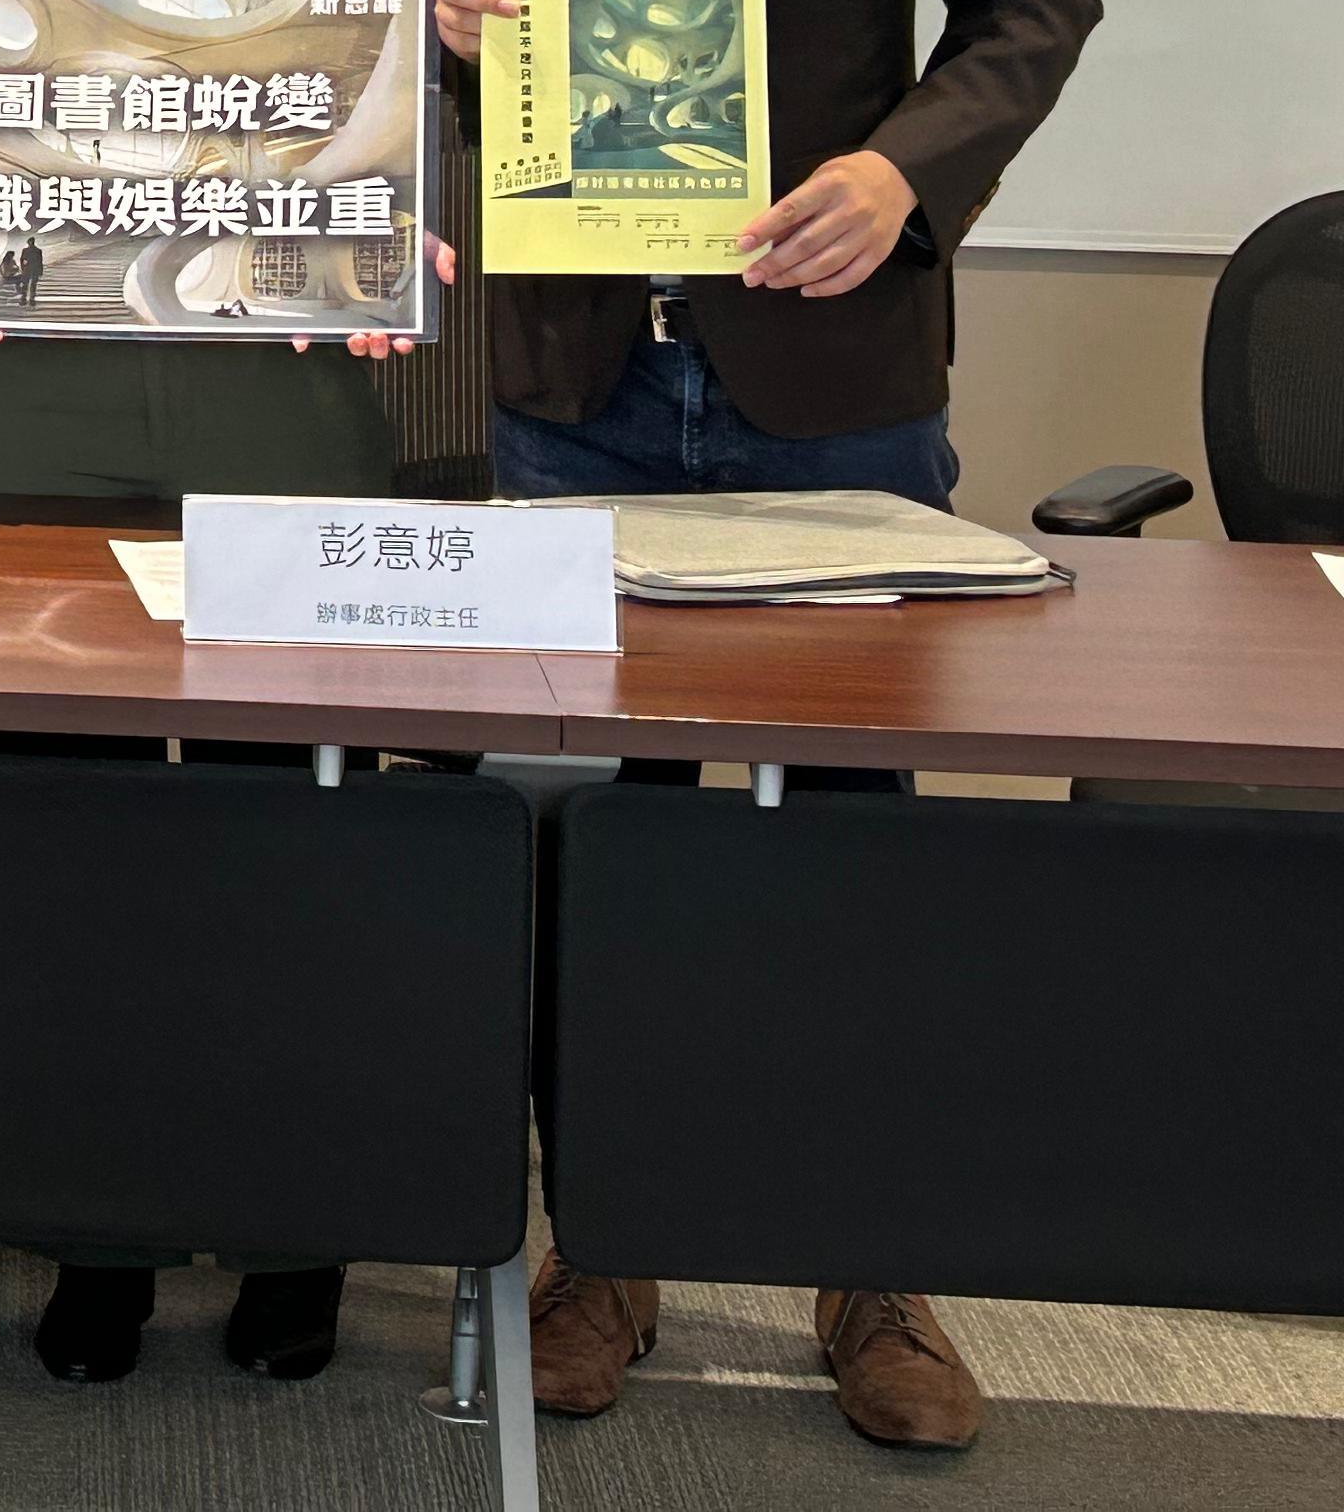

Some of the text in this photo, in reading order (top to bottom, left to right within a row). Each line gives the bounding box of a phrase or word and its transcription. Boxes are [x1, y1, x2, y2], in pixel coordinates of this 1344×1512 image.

[318, 522, 475, 572] 彭意婷
[316, 602, 479, 628] 辦事處行政主任
